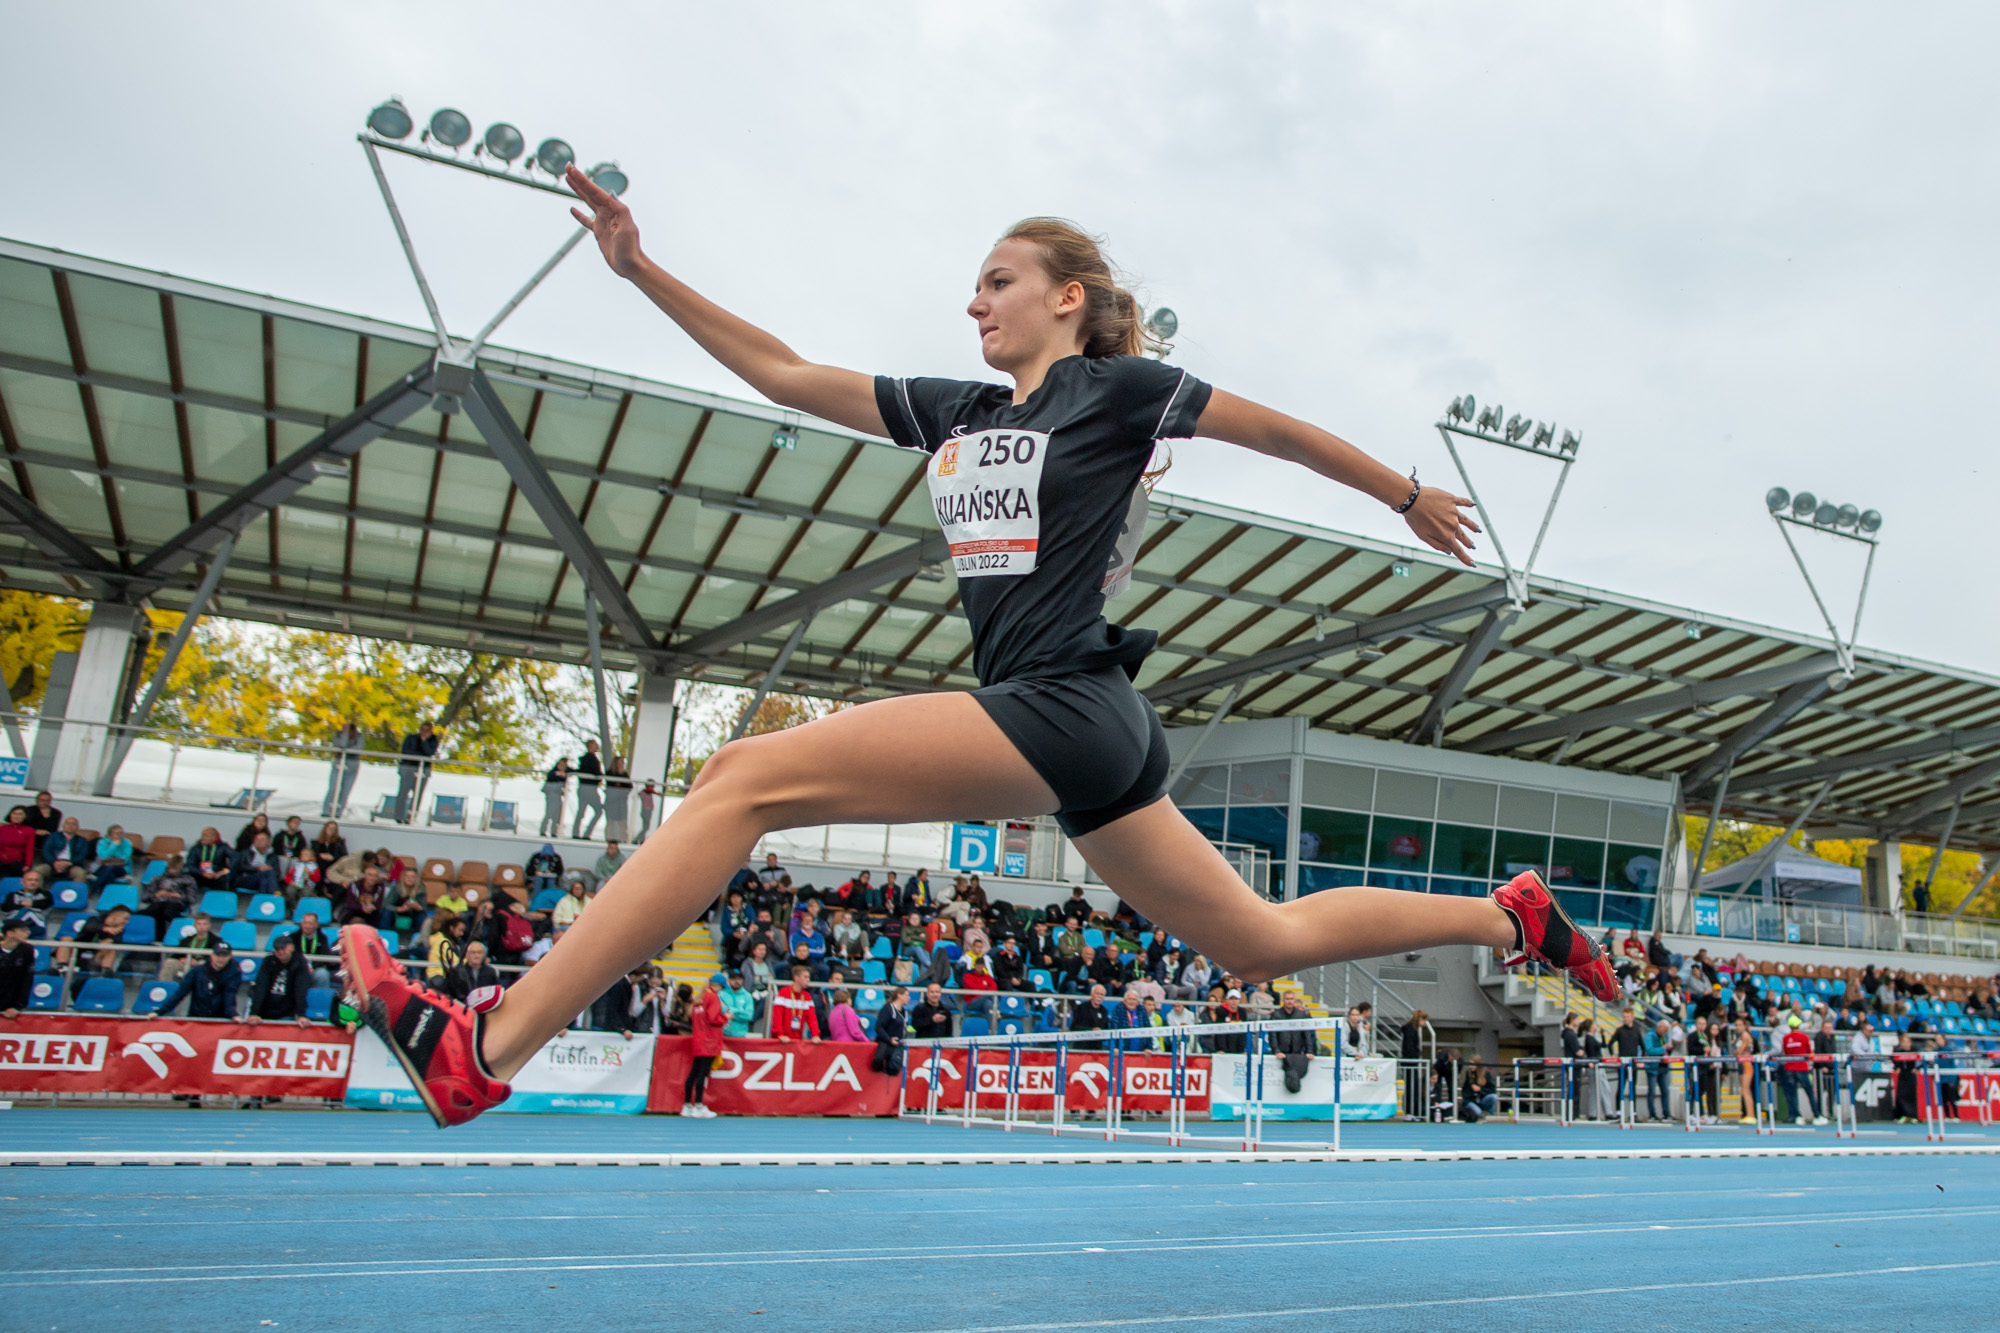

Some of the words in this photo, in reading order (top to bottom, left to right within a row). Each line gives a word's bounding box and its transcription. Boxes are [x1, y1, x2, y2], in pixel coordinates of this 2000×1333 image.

[978, 435, 1036, 467] 250
[978, 554, 1010, 569] 2022
[0, 760, 27, 774] WC
[960, 827, 989, 837] SEKTOR
[959, 836, 987, 867] D
[1006, 856, 1024, 867] WC
[1695, 910, 1719, 927] E-H
[0, 1039, 97, 1065] RLEN
[224, 1045, 340, 1071] ORLEN
[704, 1050, 864, 1091] PZLA
[979, 1069, 1054, 1089] OREN
[1854, 1078, 1889, 1107] 4F
